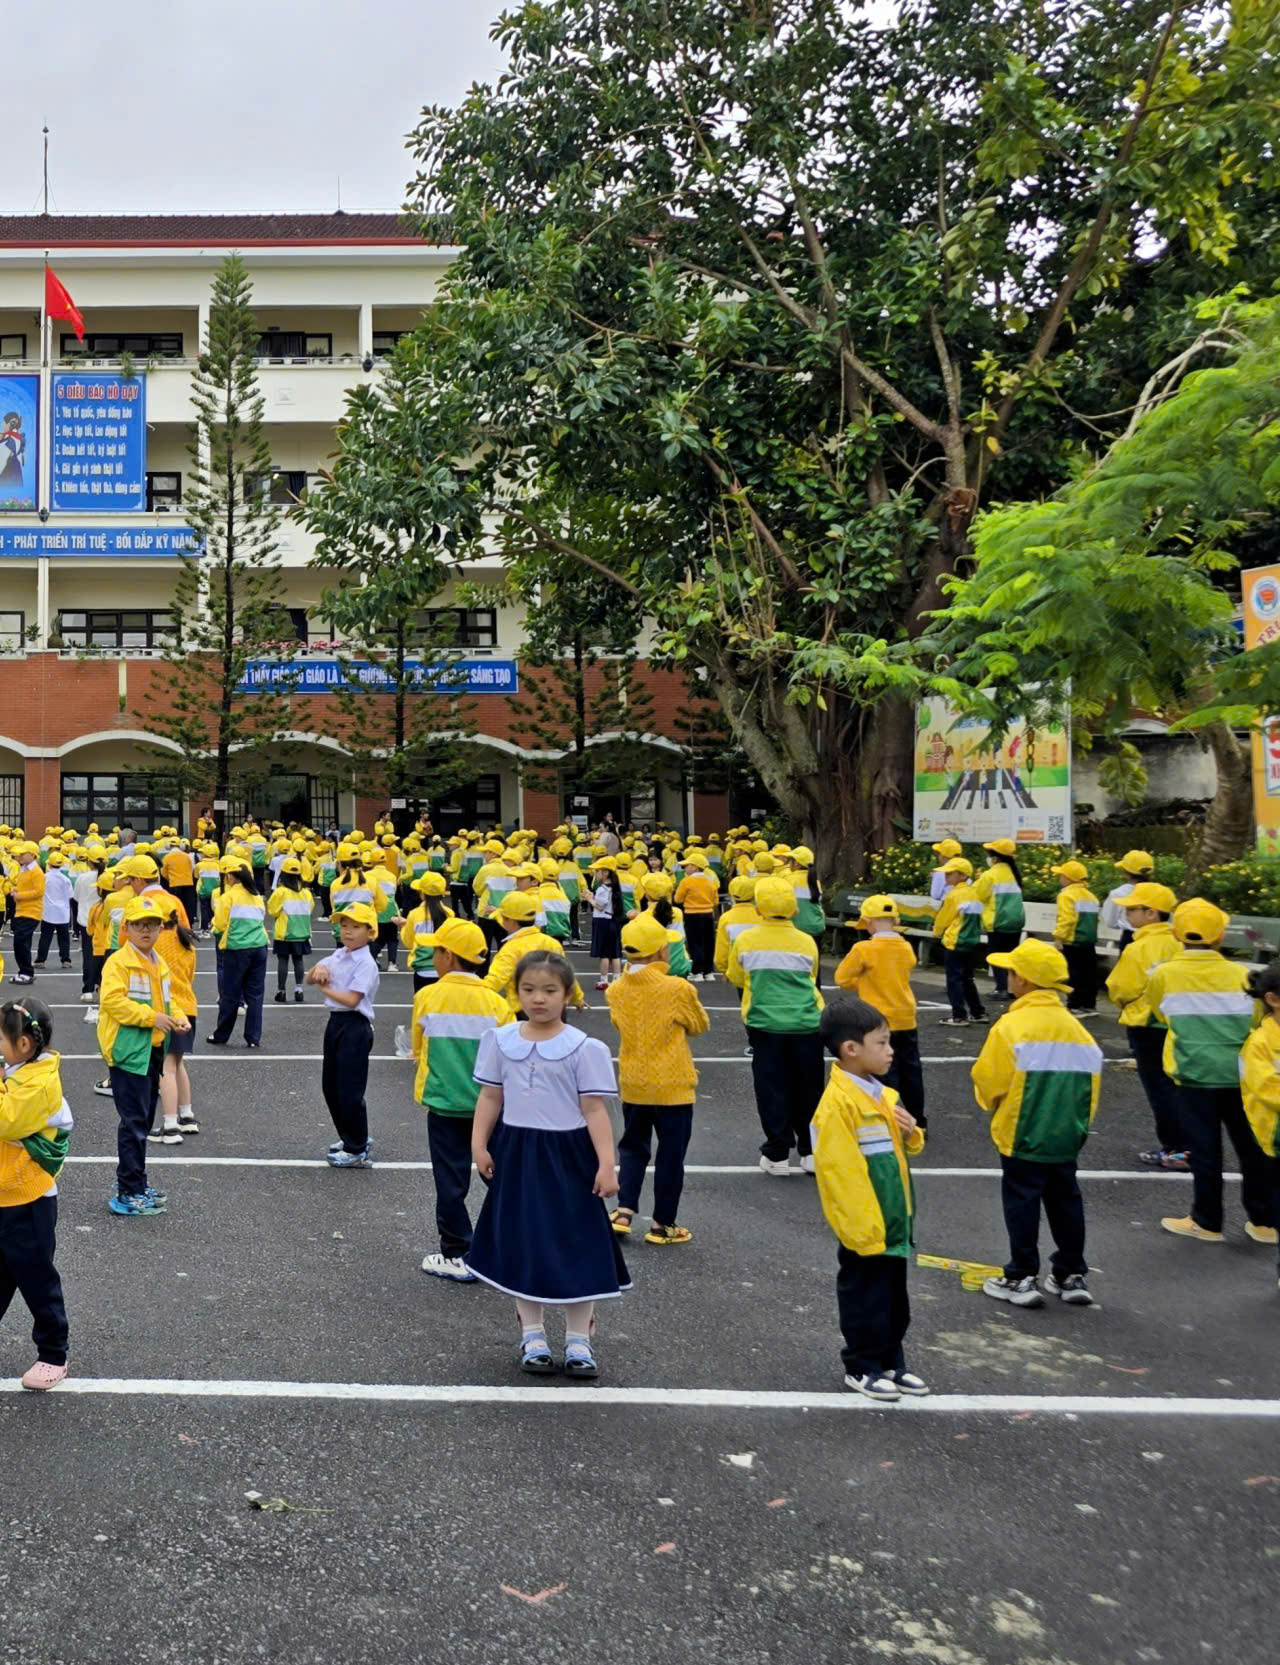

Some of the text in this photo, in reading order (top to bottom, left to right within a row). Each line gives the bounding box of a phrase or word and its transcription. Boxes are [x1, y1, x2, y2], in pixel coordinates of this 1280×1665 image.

[57, 384, 65, 400] 5
[87, 383, 105, 400] BÁC
[106, 381, 120, 400] HỒ
[121, 384, 139, 402] DẠY
[14, 532, 38, 549] PHÁT
[40, 530, 68, 549] TRIỂN
[71, 532, 87, 549] TRÍ
[89, 532, 107, 551] TUỆ
[134, 529, 154, 549] ĐẮP
[156, 532, 169, 549] KỸ
[306, 665, 326, 684] GIÁO
[326, 665, 338, 684] LÀ
[470, 664, 494, 684] SÁNG
[494, 667, 511, 687] TẠO
